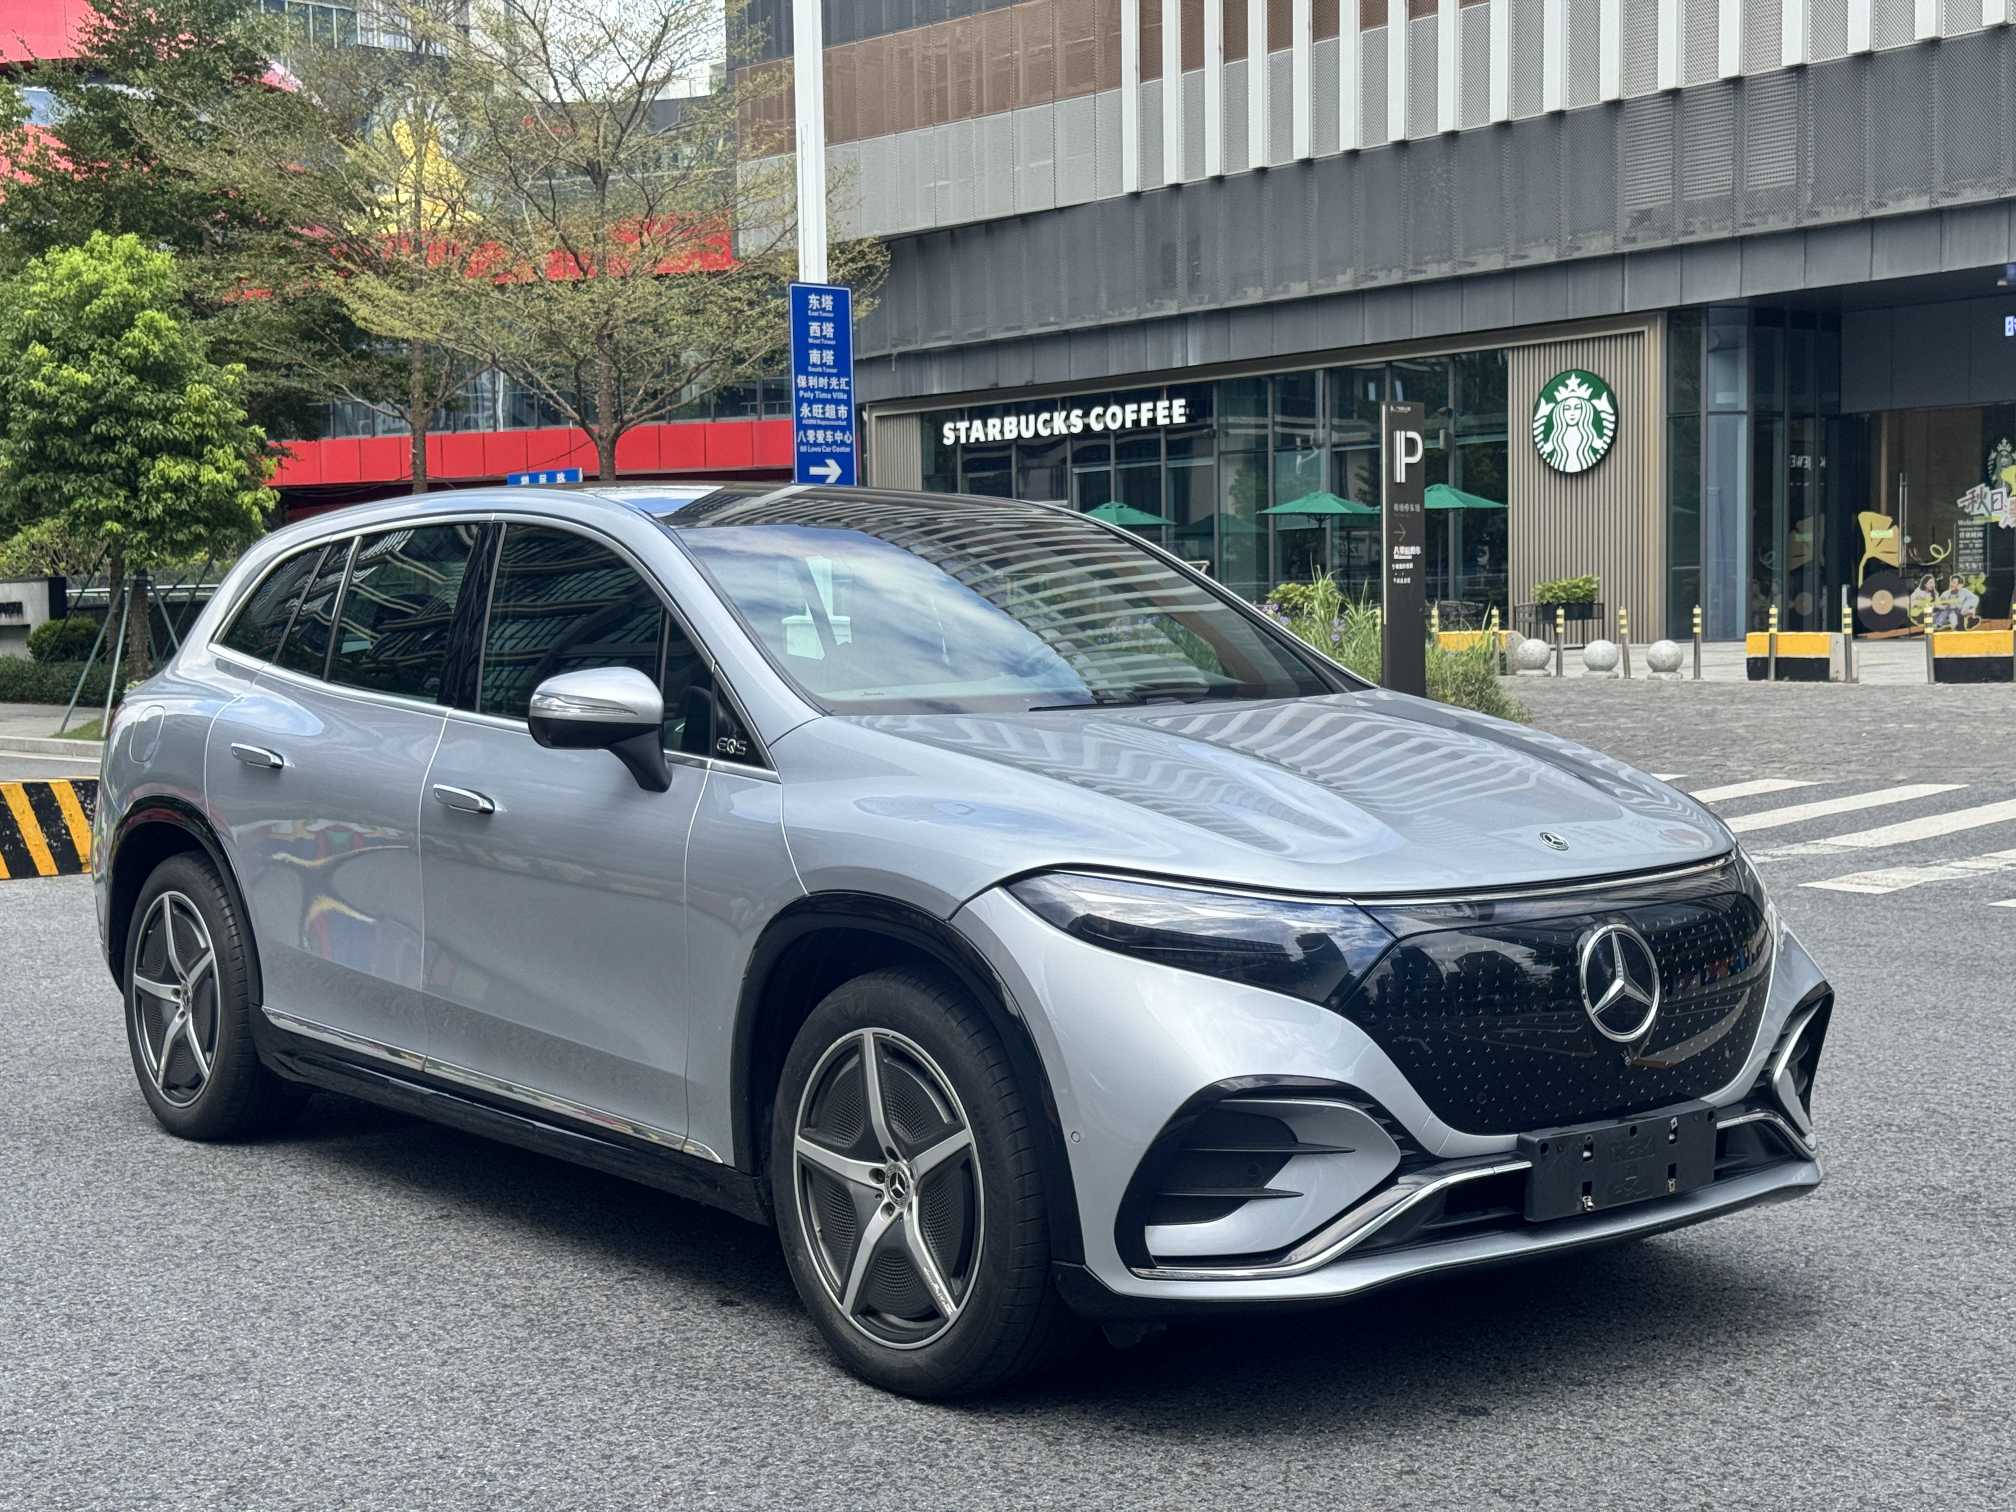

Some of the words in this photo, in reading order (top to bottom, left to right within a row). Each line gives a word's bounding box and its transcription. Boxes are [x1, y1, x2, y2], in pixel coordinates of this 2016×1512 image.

[808, 293, 834, 311] 东塔
[808, 322, 834, 338] 西塔
[808, 349, 834, 366] 南塔
[797, 375, 850, 390] 保利时光汇
[799, 390, 814, 400] Poly
[815, 391, 832, 399] Time
[800, 403, 849, 420] 永旺超市
[942, 408, 1084, 446] STARBUCKS
[1089, 398, 1187, 431] COFFEE
[797, 429, 853, 444] 八零爱车中心
[1393, 430, 1424, 483] P
[716, 736, 748, 756] EQS
